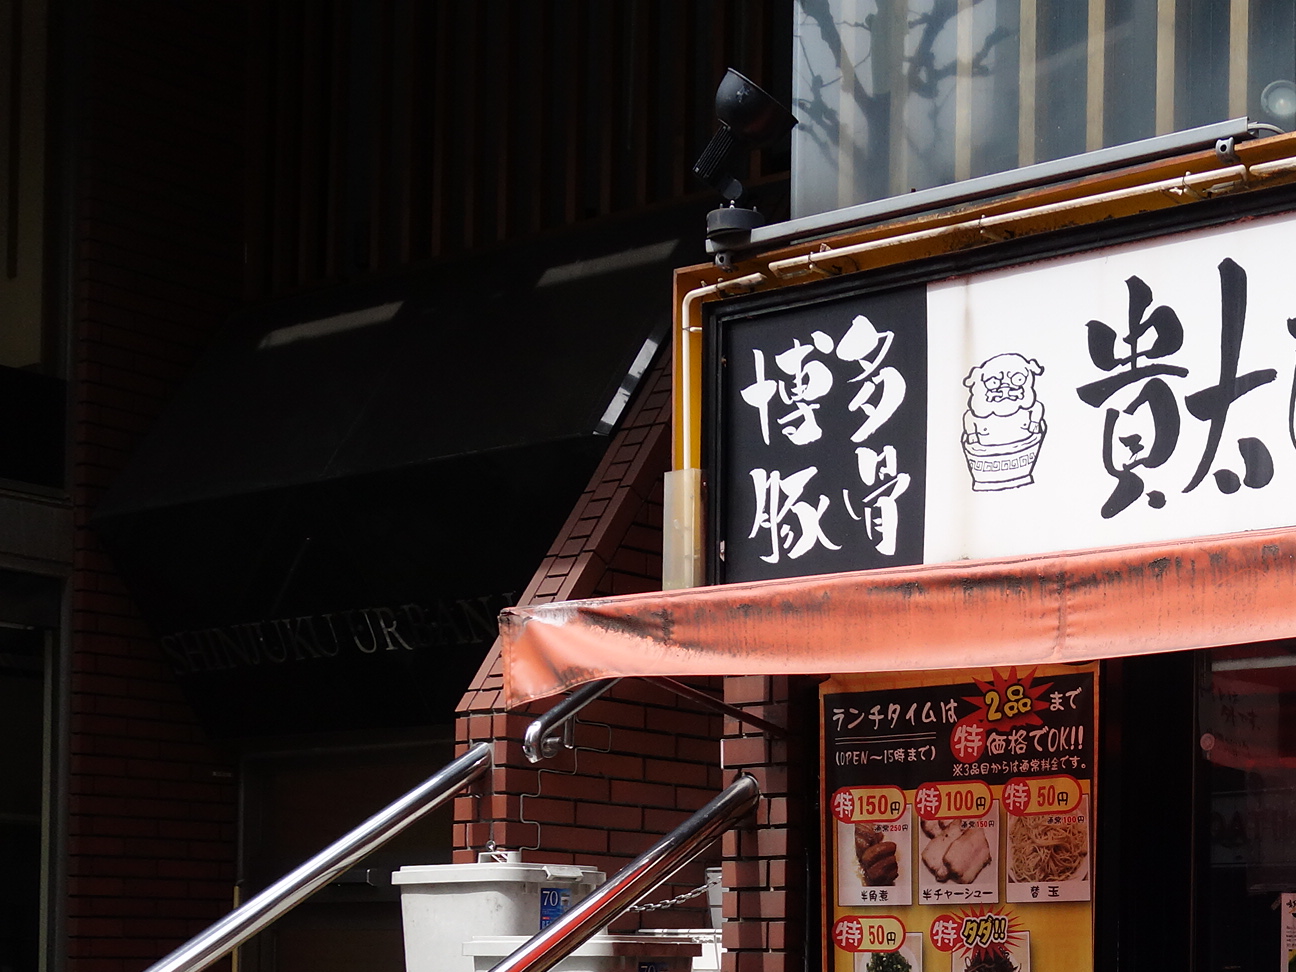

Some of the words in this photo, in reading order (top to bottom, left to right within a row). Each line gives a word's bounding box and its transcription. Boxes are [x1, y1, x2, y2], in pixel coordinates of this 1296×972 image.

[741, 314, 907, 446] 博多
[749, 446, 911, 564] 豚骨
[832, 699, 958, 731] ランチタイムは
[984, 684, 1032, 721] 2品
[1049, 687, 1083, 711] まで
[953, 724, 984, 757] 特
[834, 791, 854, 818] 特
[857, 793, 901, 816] 150円
[916, 787, 940, 815] 特
[945, 789, 987, 812] 100円
[1004, 783, 1028, 810] 特
[1037, 784, 1069, 808] 50円
[542, 890, 559, 907] 70
[835, 920, 861, 946] 特
[868, 924, 897, 946] 50円
[933, 920, 958, 946] 特
[962, 916, 1007, 945] タダ!!
